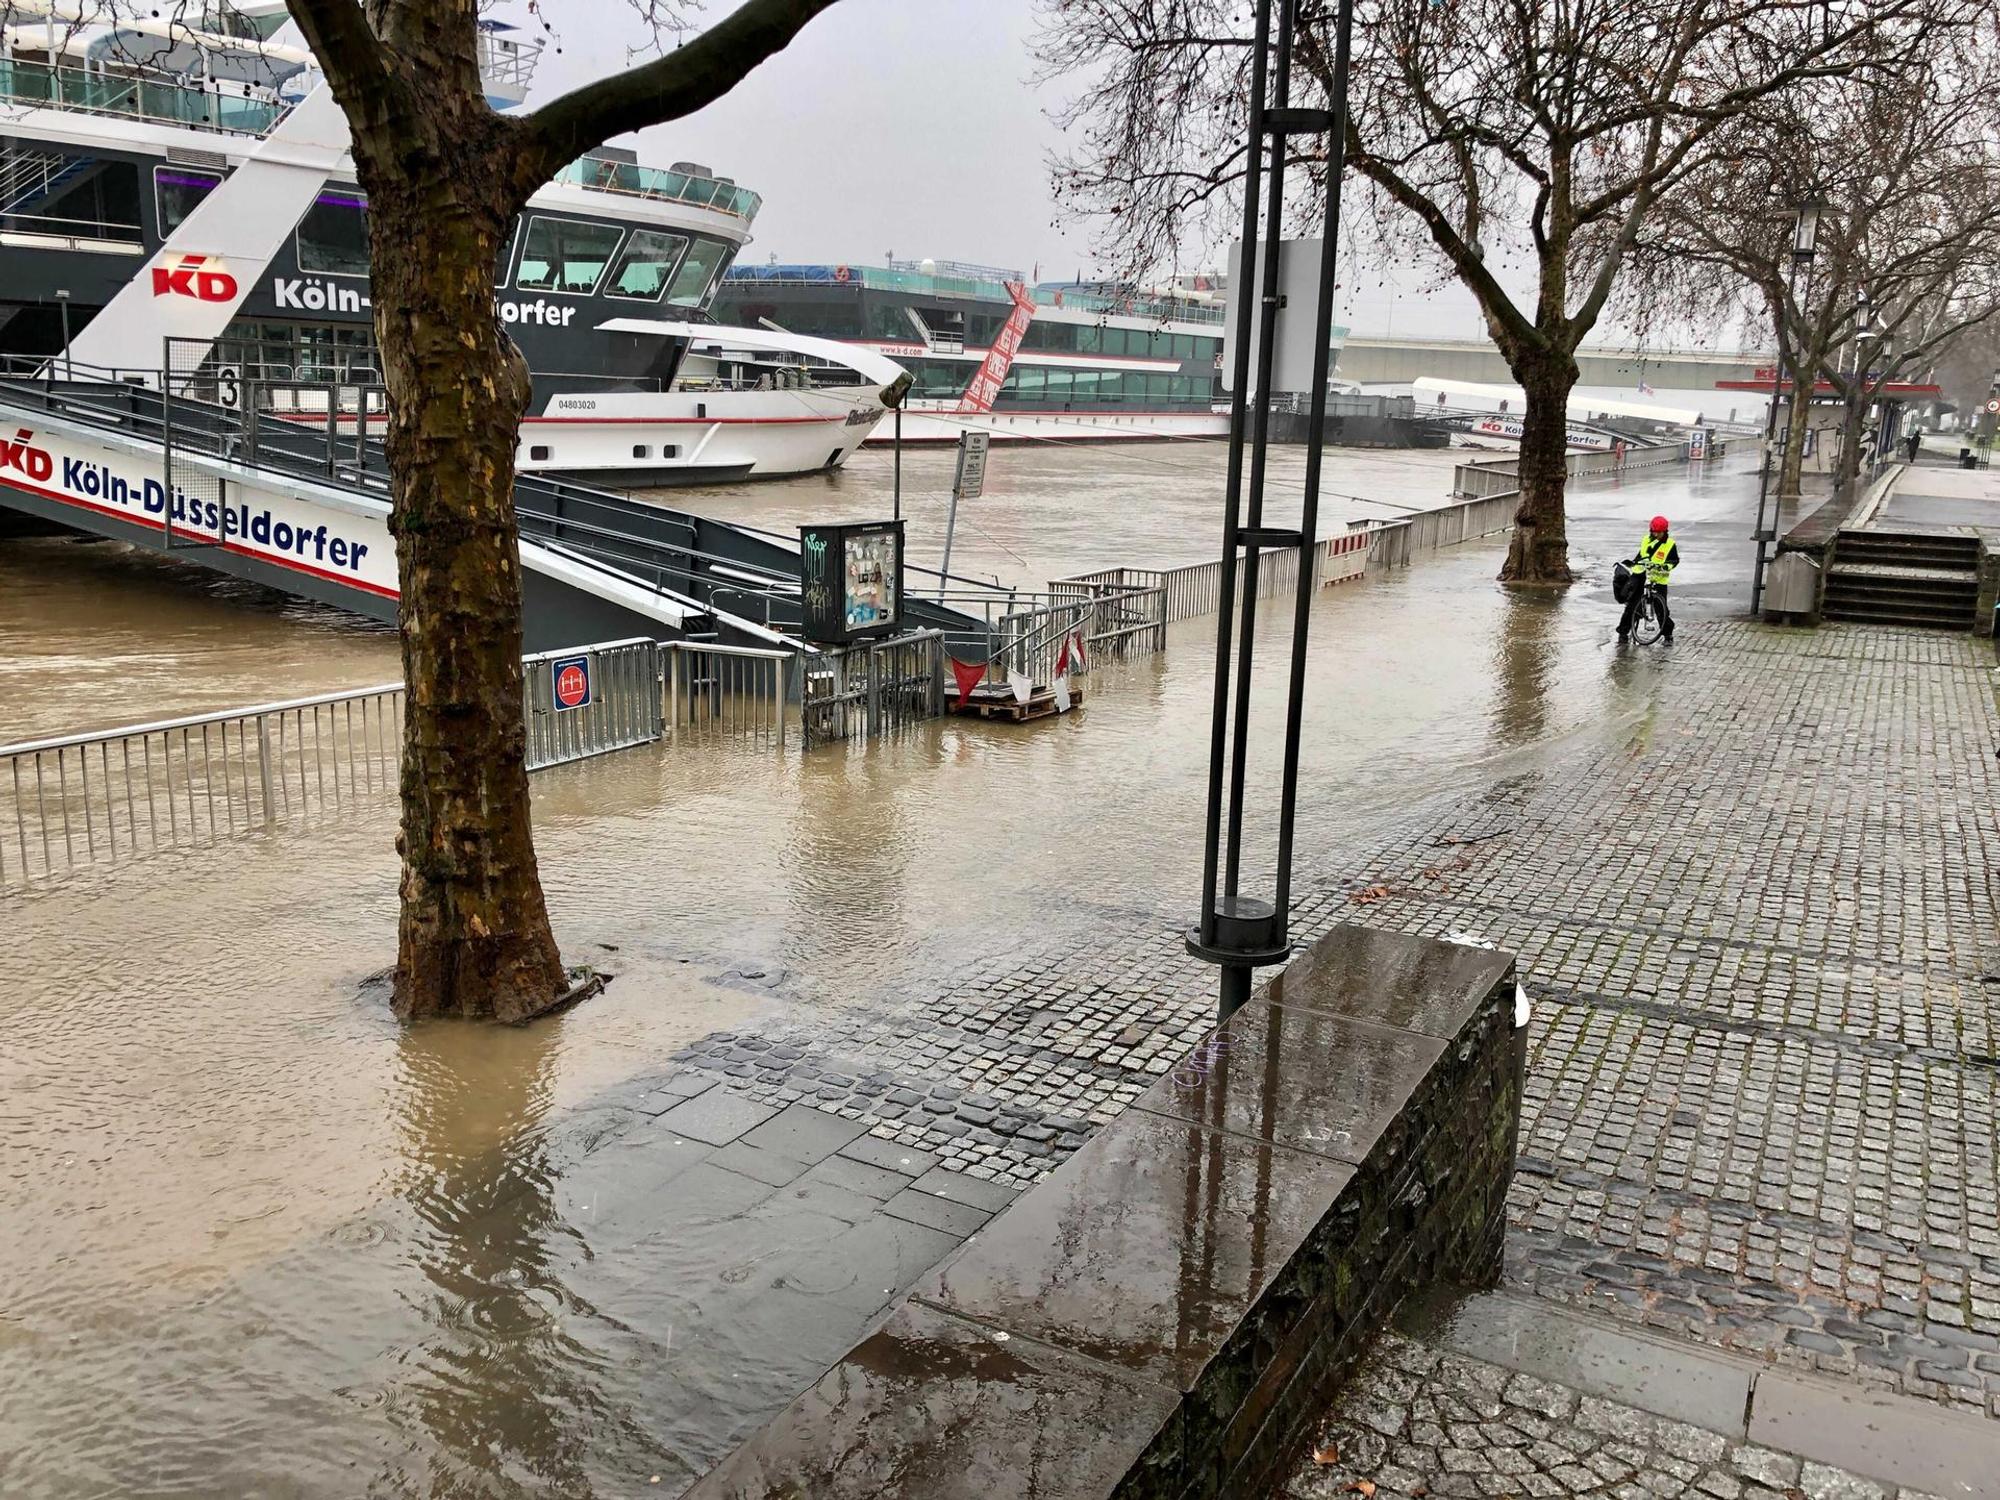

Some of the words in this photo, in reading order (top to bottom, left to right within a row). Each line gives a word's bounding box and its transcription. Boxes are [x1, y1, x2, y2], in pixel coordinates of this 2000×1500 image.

[152, 268, 238, 303] KD
[497, 299, 576, 327] orfer
[221, 368, 238, 408] 3
[558, 400, 596, 410] 04803020
[63, 456, 369, 571] Köln-Düsseldorfer
